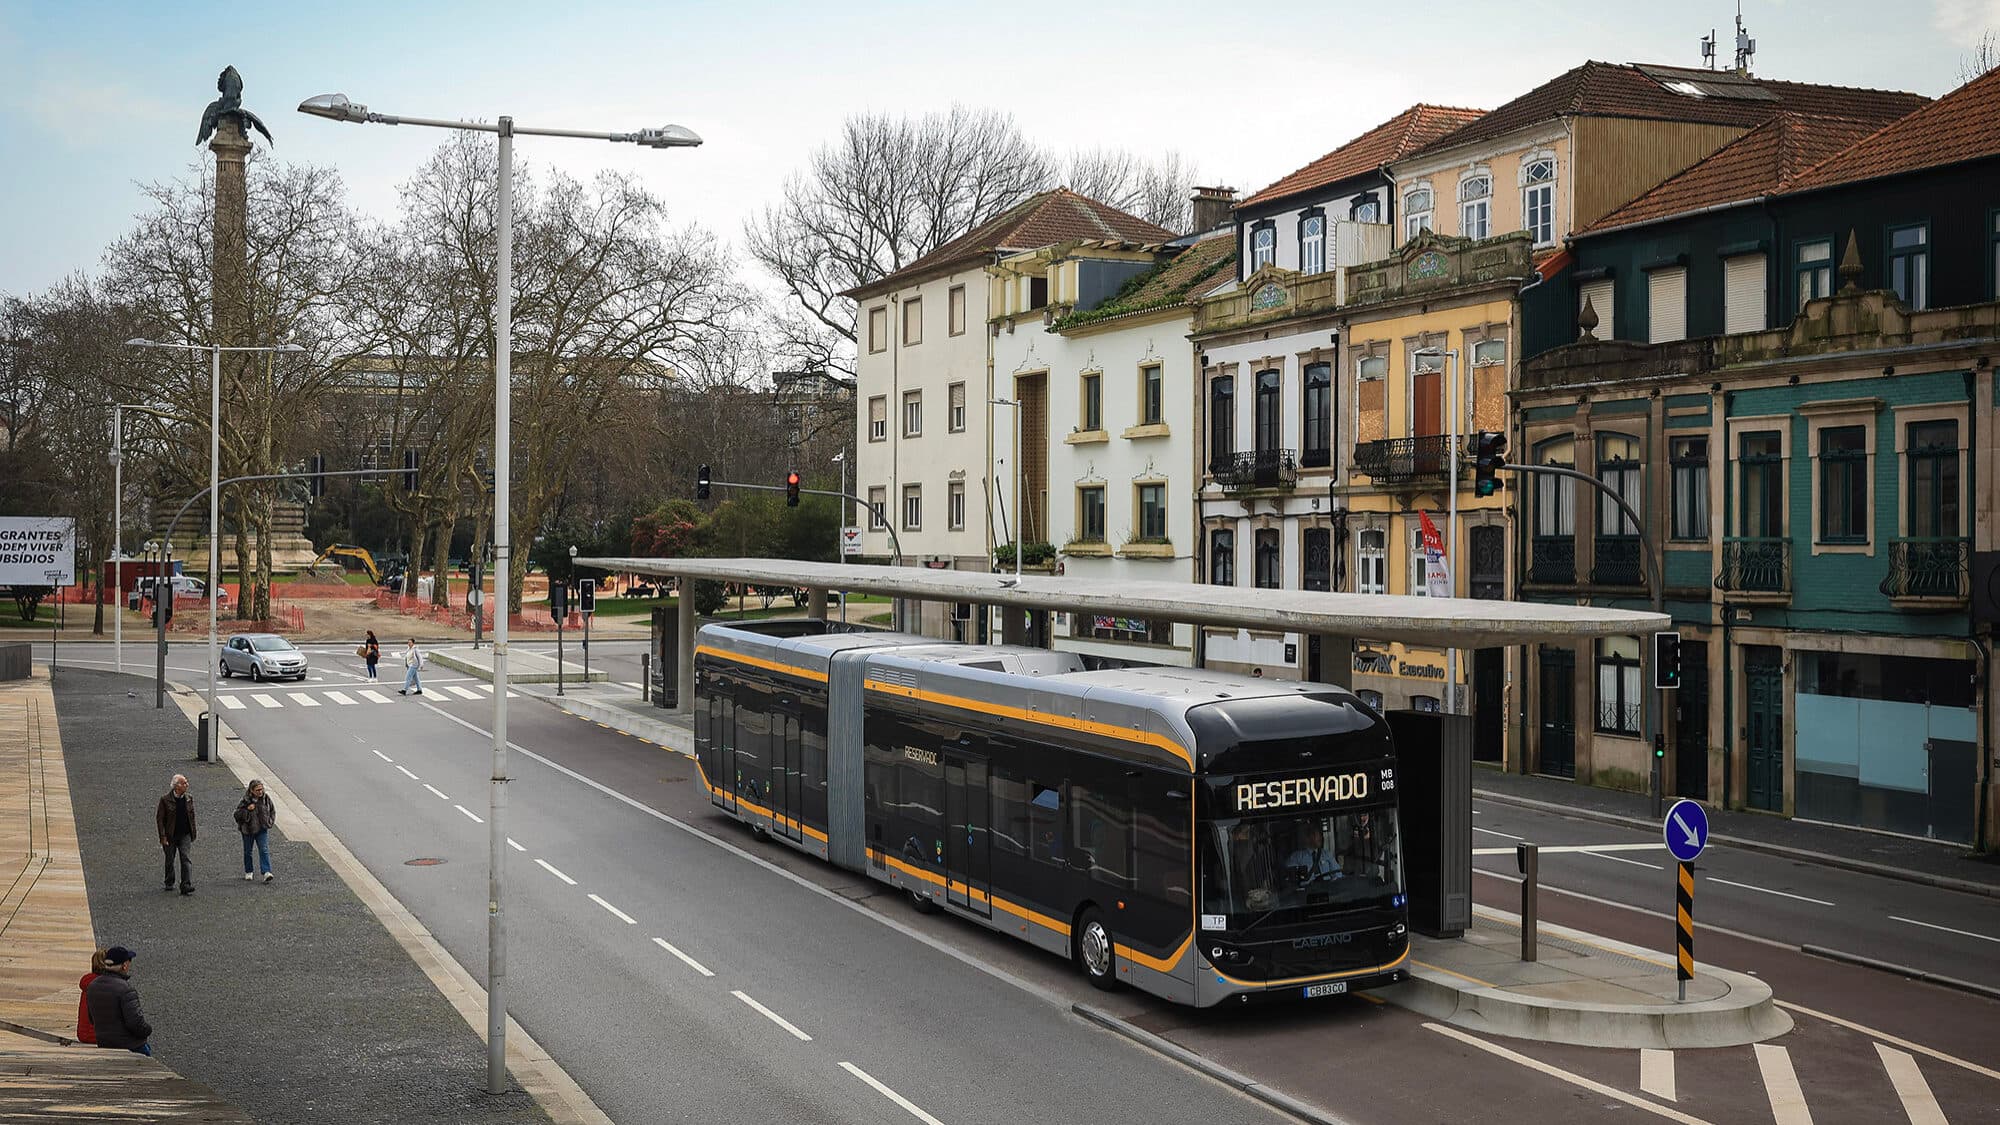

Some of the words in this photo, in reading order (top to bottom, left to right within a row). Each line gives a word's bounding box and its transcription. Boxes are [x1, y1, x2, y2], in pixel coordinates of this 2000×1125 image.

[0, 530, 61, 540] GRANTES
[30, 542, 63, 552] VIVER
[1399, 661, 1445, 679] Executivo
[1237, 772, 1368, 811] RESERVADO
[1292, 932, 1352, 949] CAETANO
